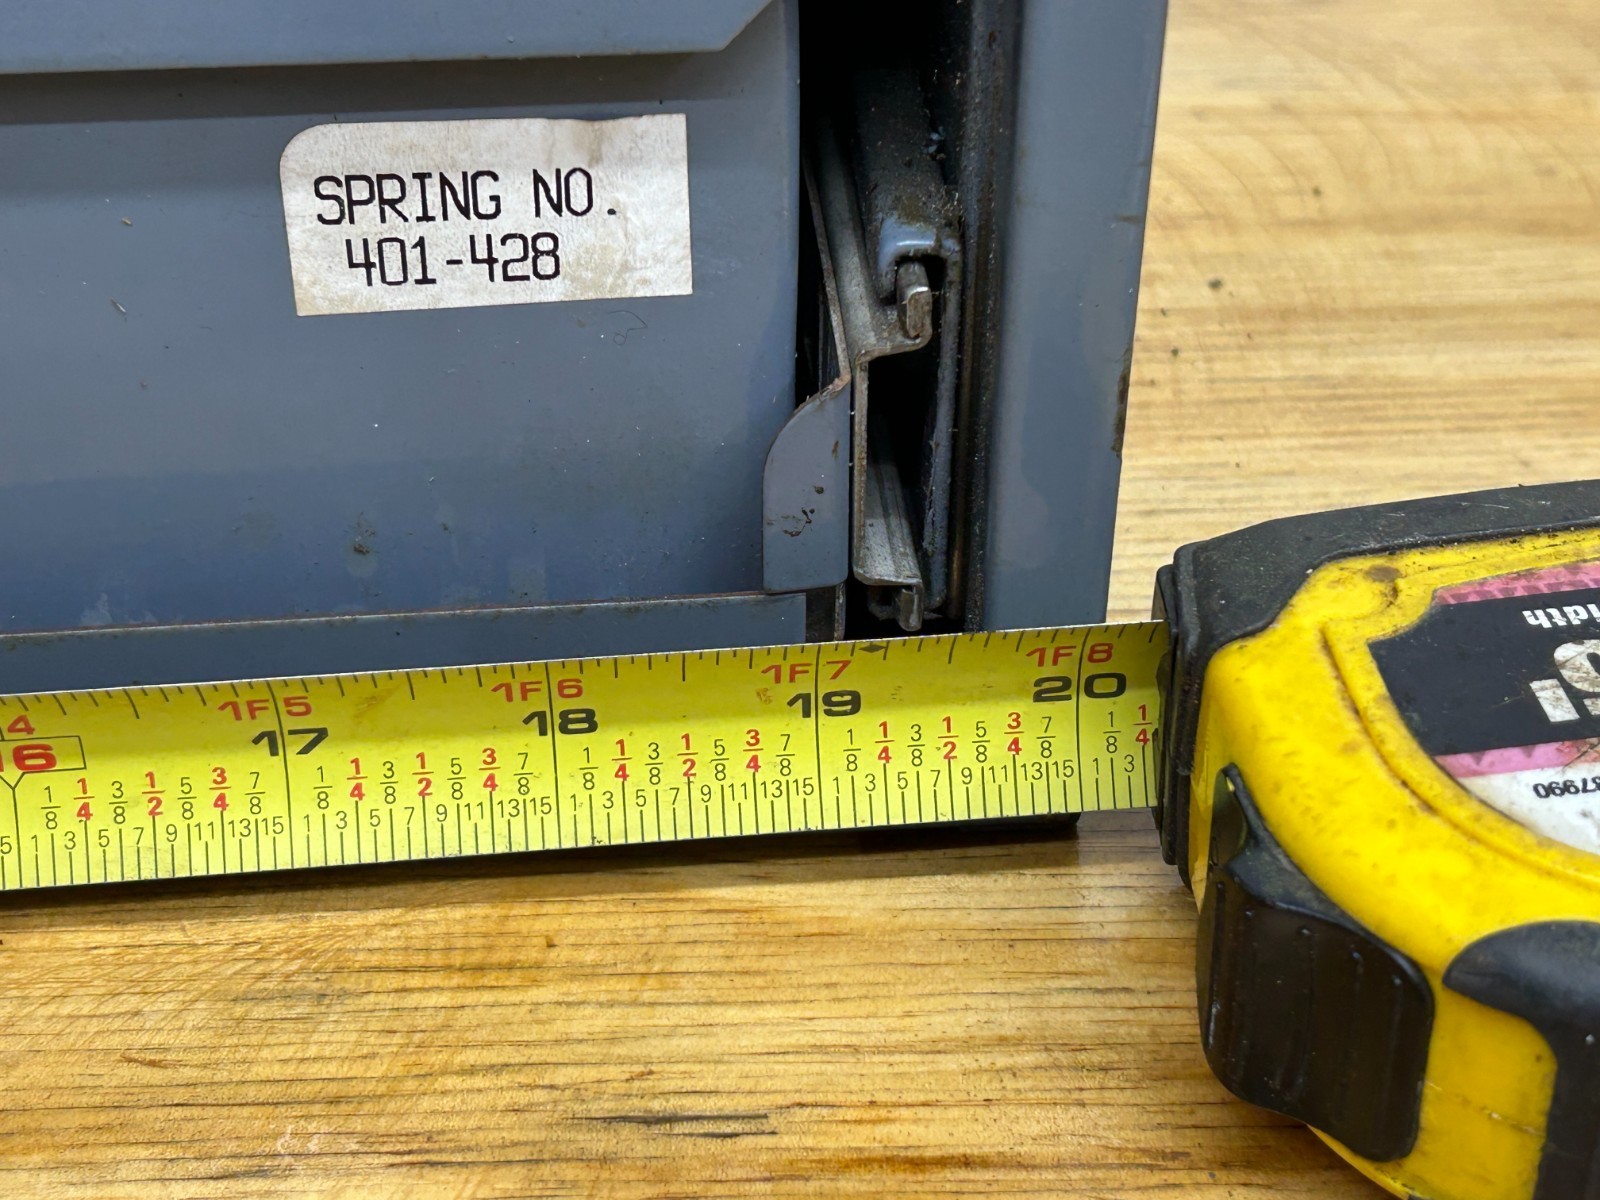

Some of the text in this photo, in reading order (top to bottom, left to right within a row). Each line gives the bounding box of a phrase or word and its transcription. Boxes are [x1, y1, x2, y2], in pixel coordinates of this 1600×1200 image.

[314, 167, 617, 225] SPRING NO.
[345, 232, 561, 287] 401-428
[0, 672, 1127, 772] 6 17 18 19 20
